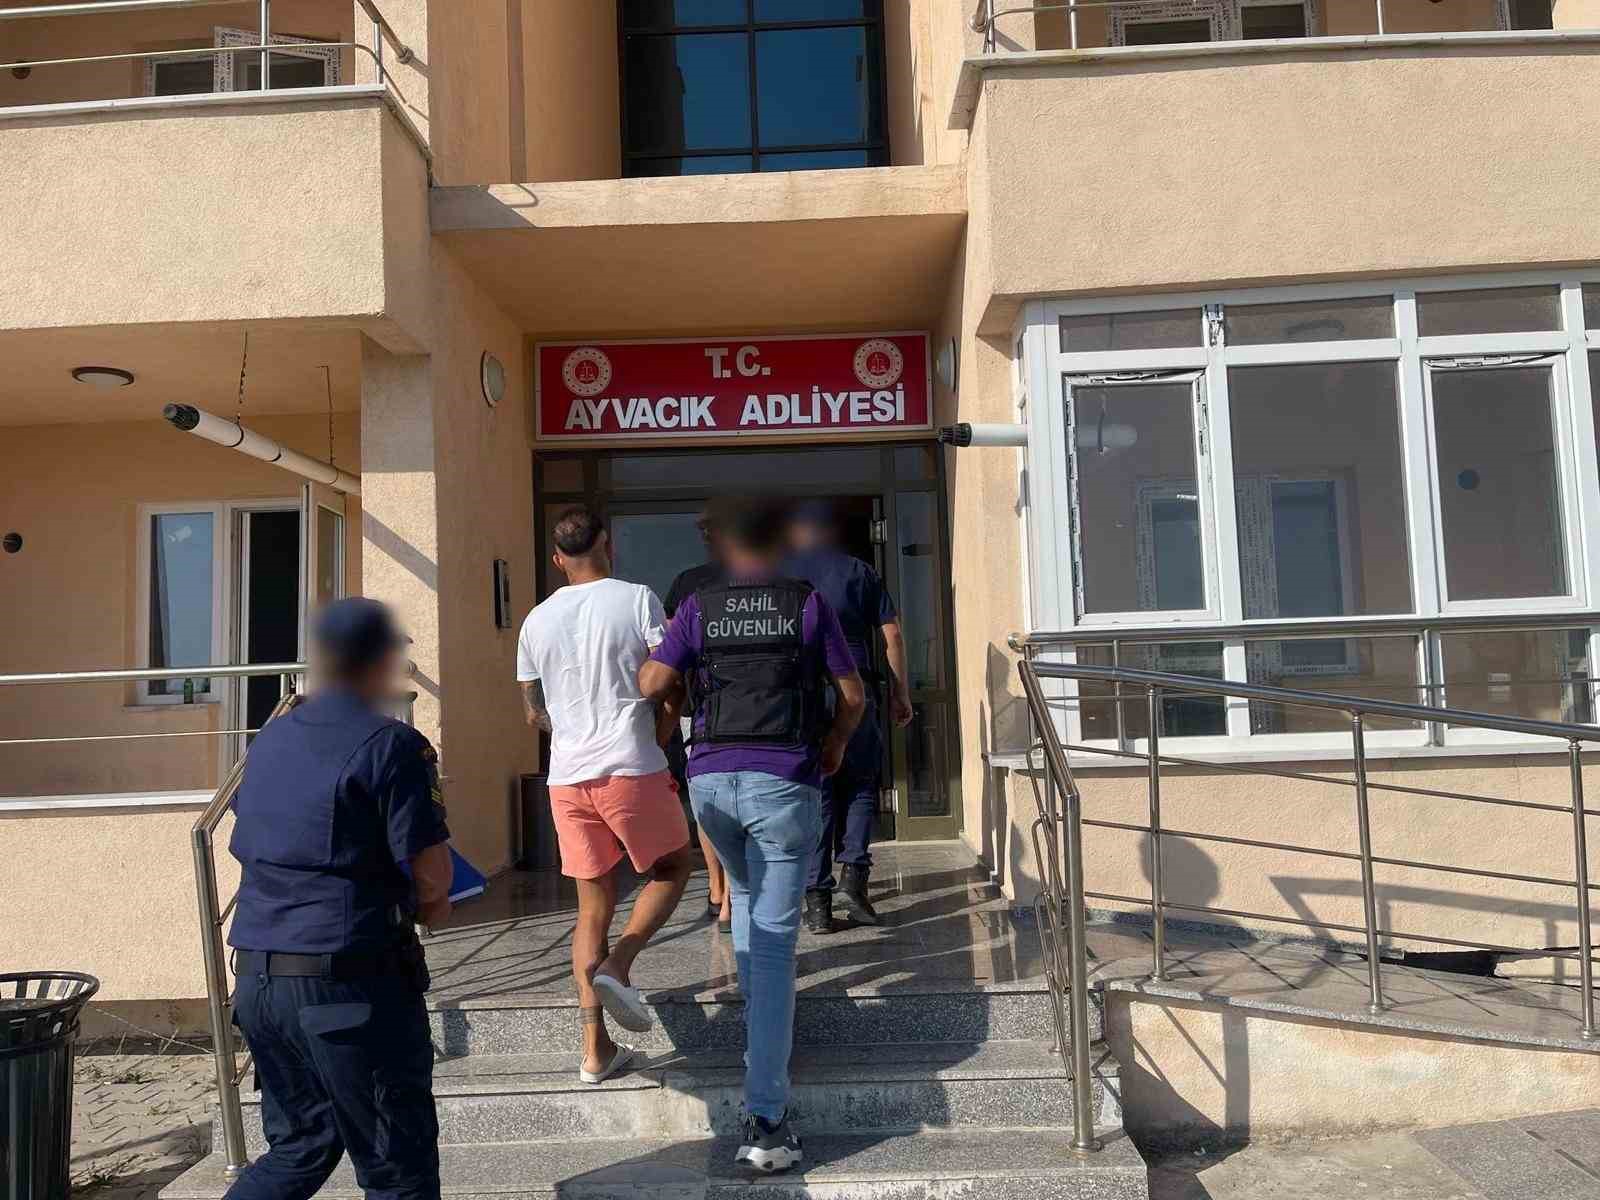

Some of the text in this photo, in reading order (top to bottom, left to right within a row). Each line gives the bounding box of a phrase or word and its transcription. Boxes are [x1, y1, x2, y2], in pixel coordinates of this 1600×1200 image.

[704, 345, 771, 378] T.C.
[564, 383, 905, 430] AYVACIK ADLİYESİ
[725, 593, 778, 613] SAHİL
[706, 614, 795, 638] GÜVENLİK
